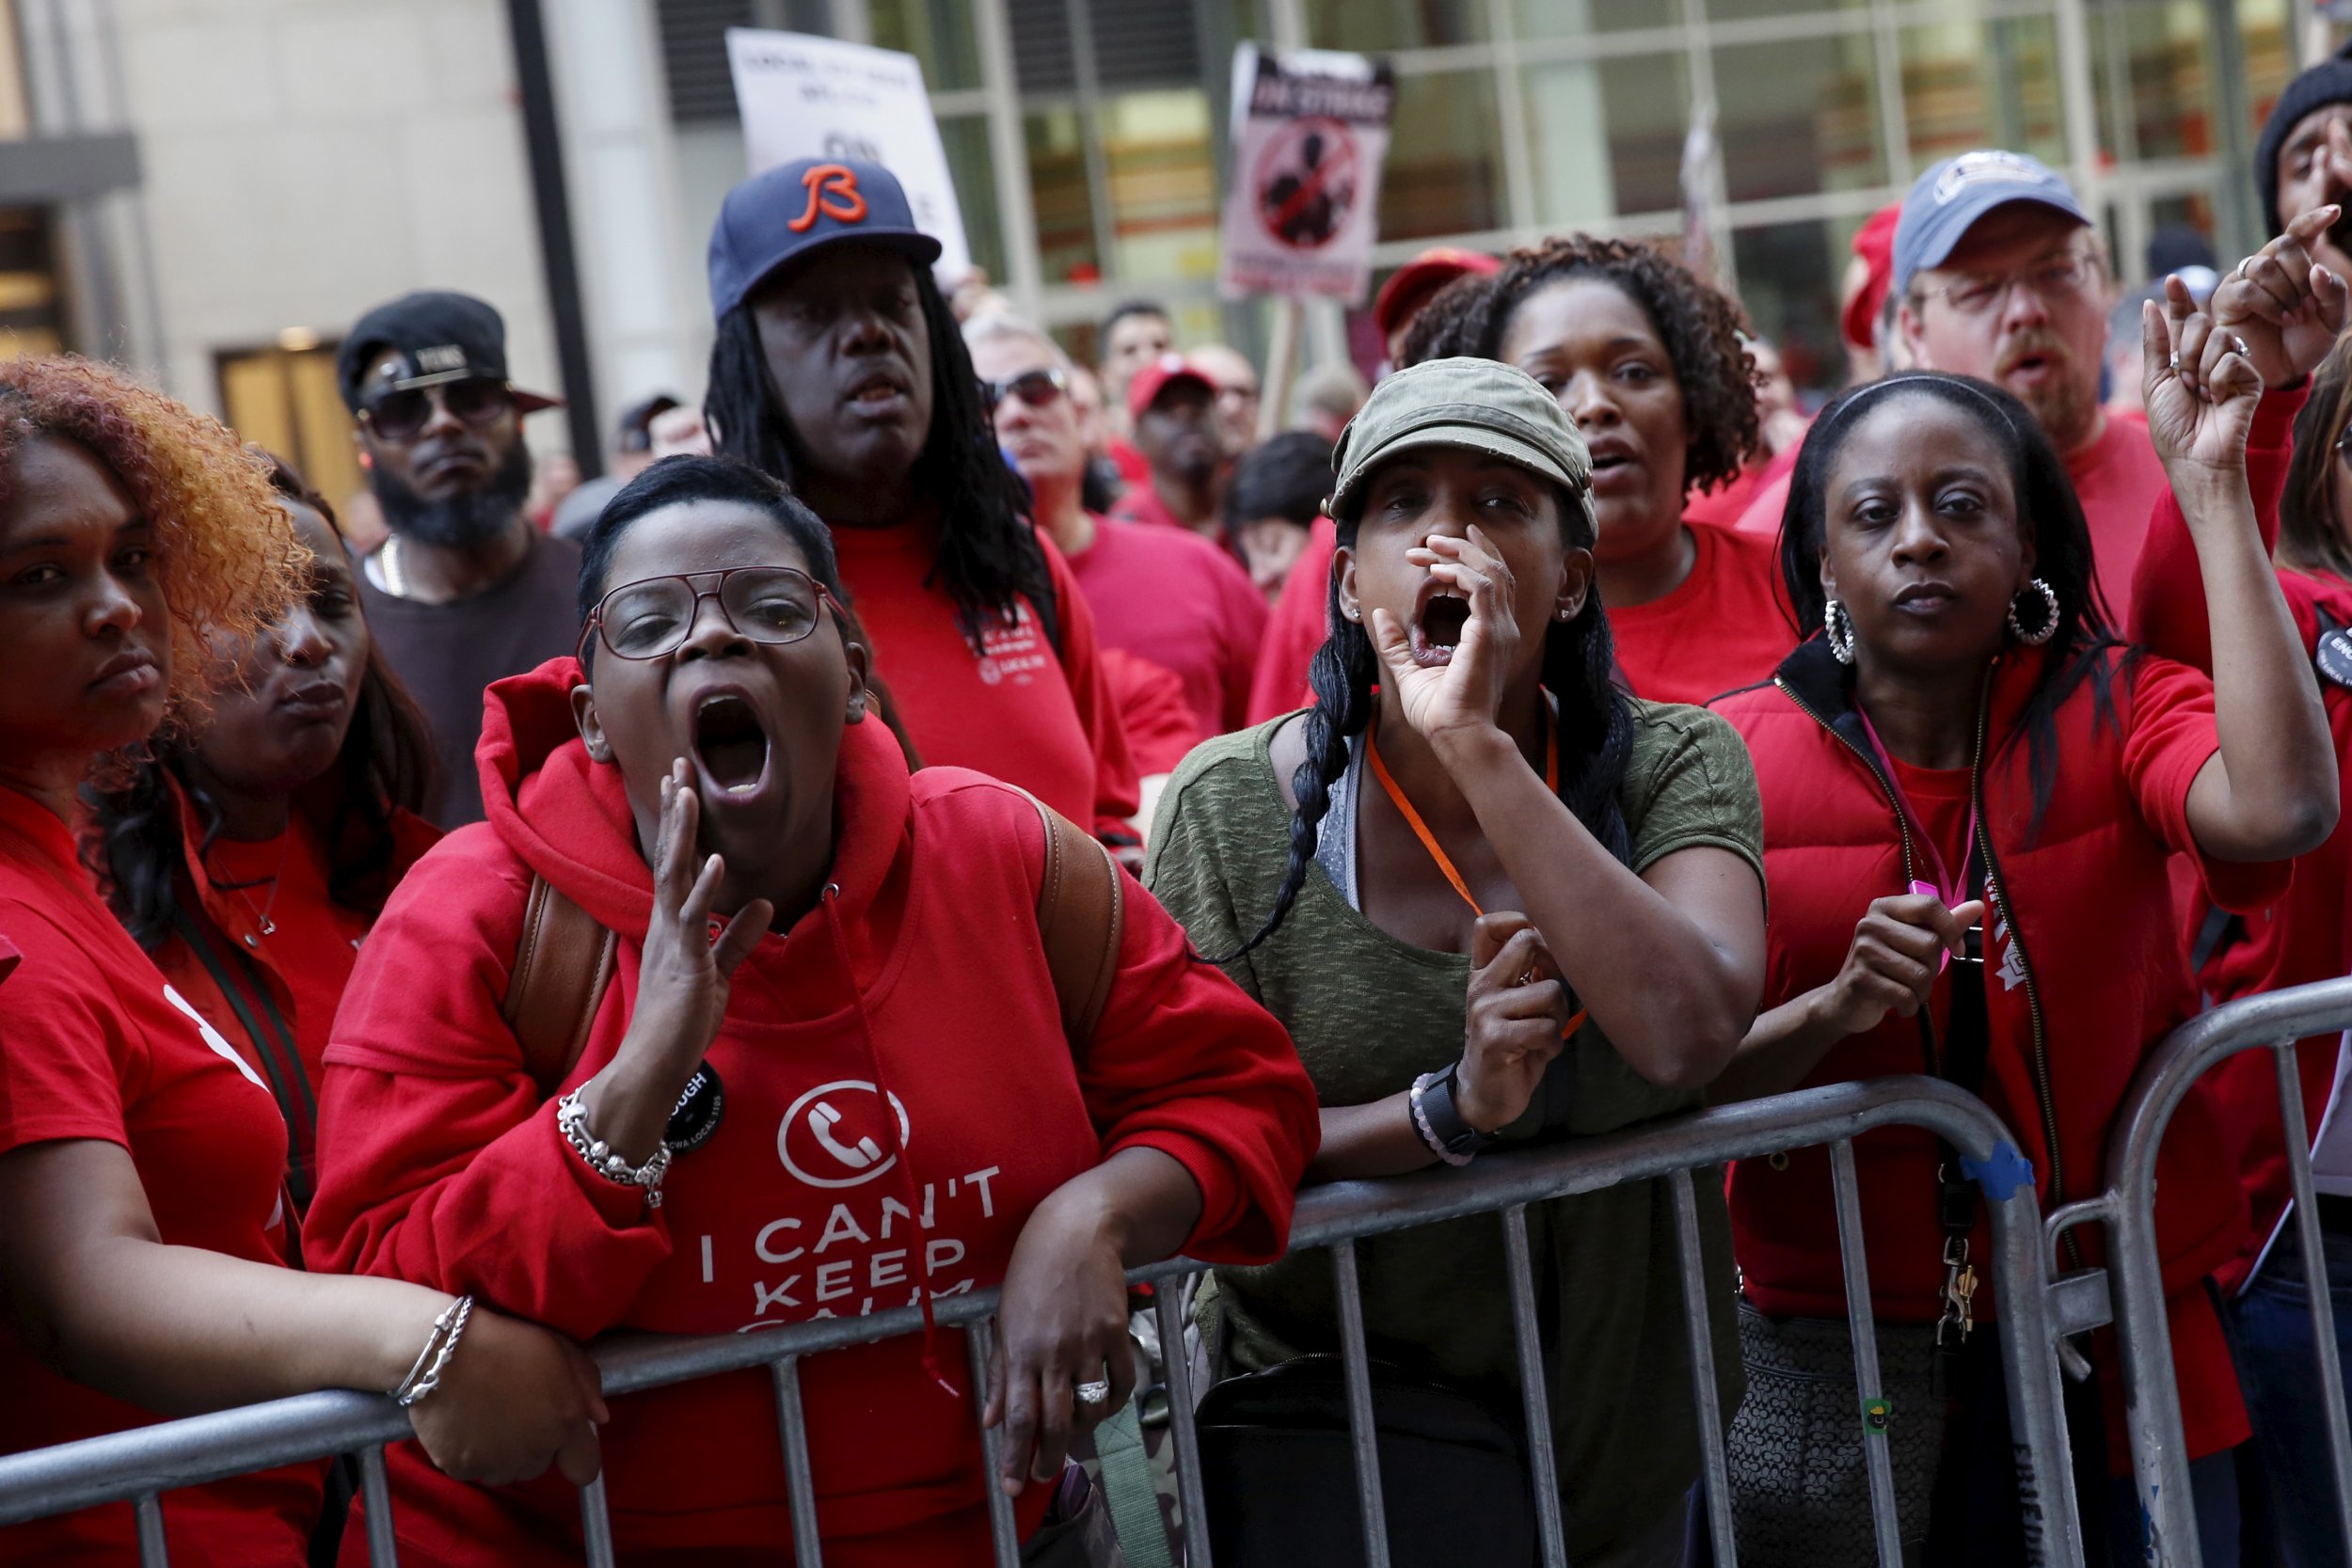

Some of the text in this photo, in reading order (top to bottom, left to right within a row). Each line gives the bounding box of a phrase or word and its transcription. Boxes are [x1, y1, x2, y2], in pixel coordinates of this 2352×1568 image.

[787, 164, 867, 232] B
[691, 1119, 715, 1143] LOCAL
[701, 1165, 1000, 1282] I CAN'T
[753, 1239, 965, 1316] KEEP
